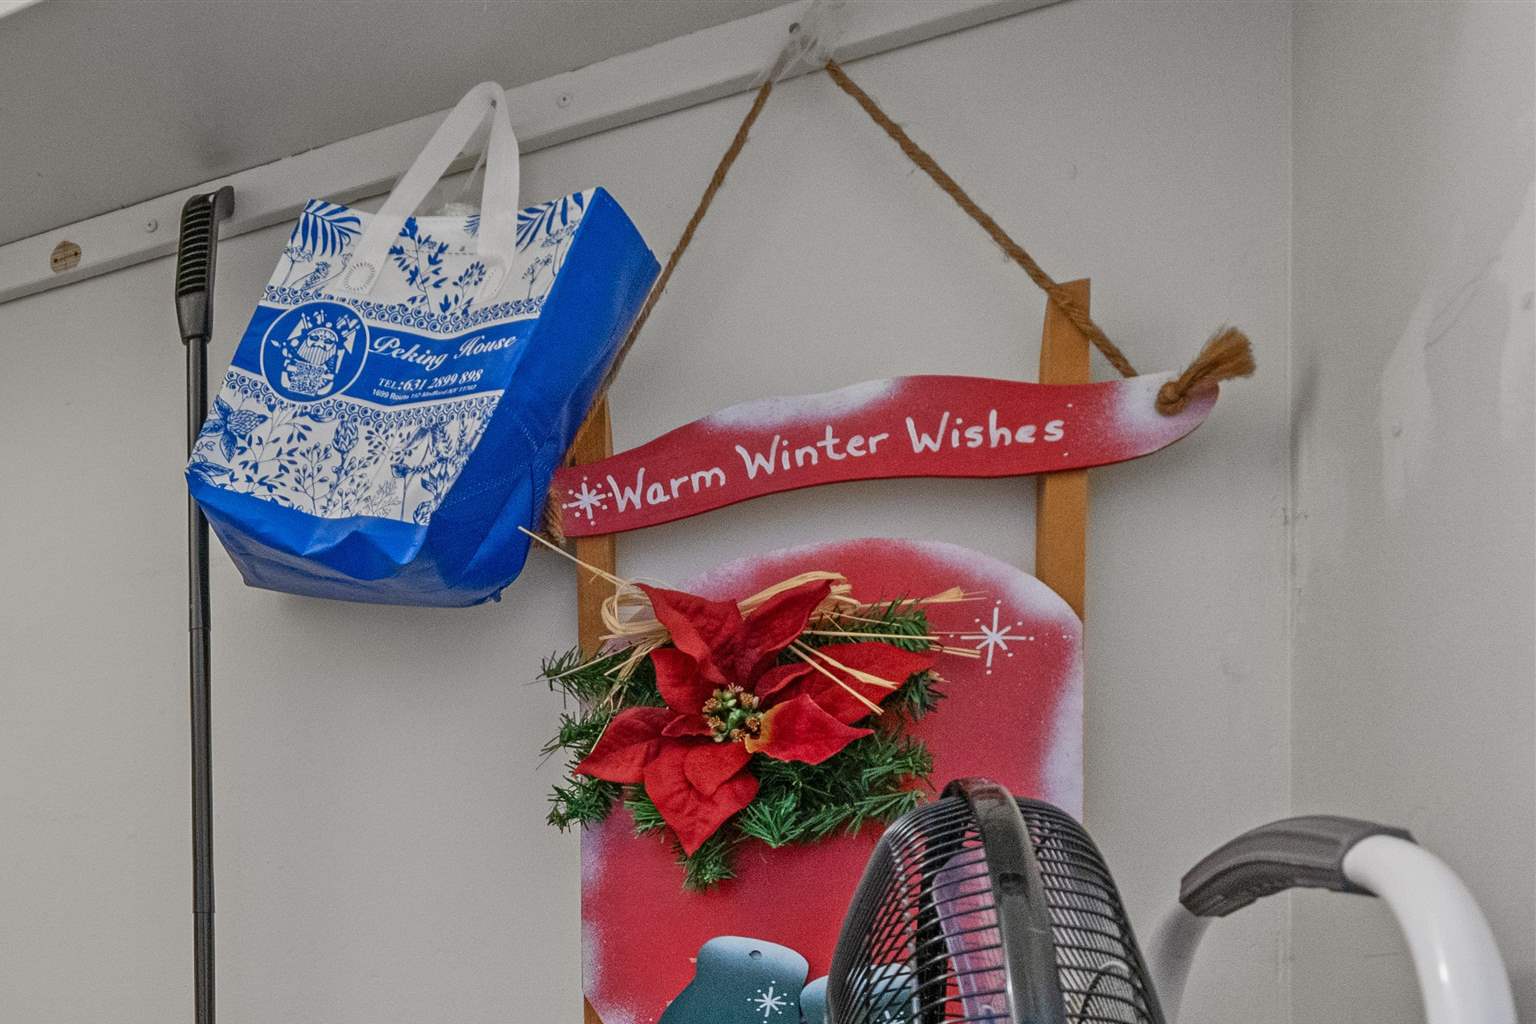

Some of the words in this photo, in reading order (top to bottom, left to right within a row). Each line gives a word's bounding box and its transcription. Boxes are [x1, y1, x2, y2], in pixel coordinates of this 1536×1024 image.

[371, 336, 448, 371] Peking
[453, 335, 518, 360] House
[459, 368, 484, 383] 898
[604, 464, 727, 514] Warm
[736, 426, 889, 482] Winter
[904, 408, 1065, 454] Wishes
